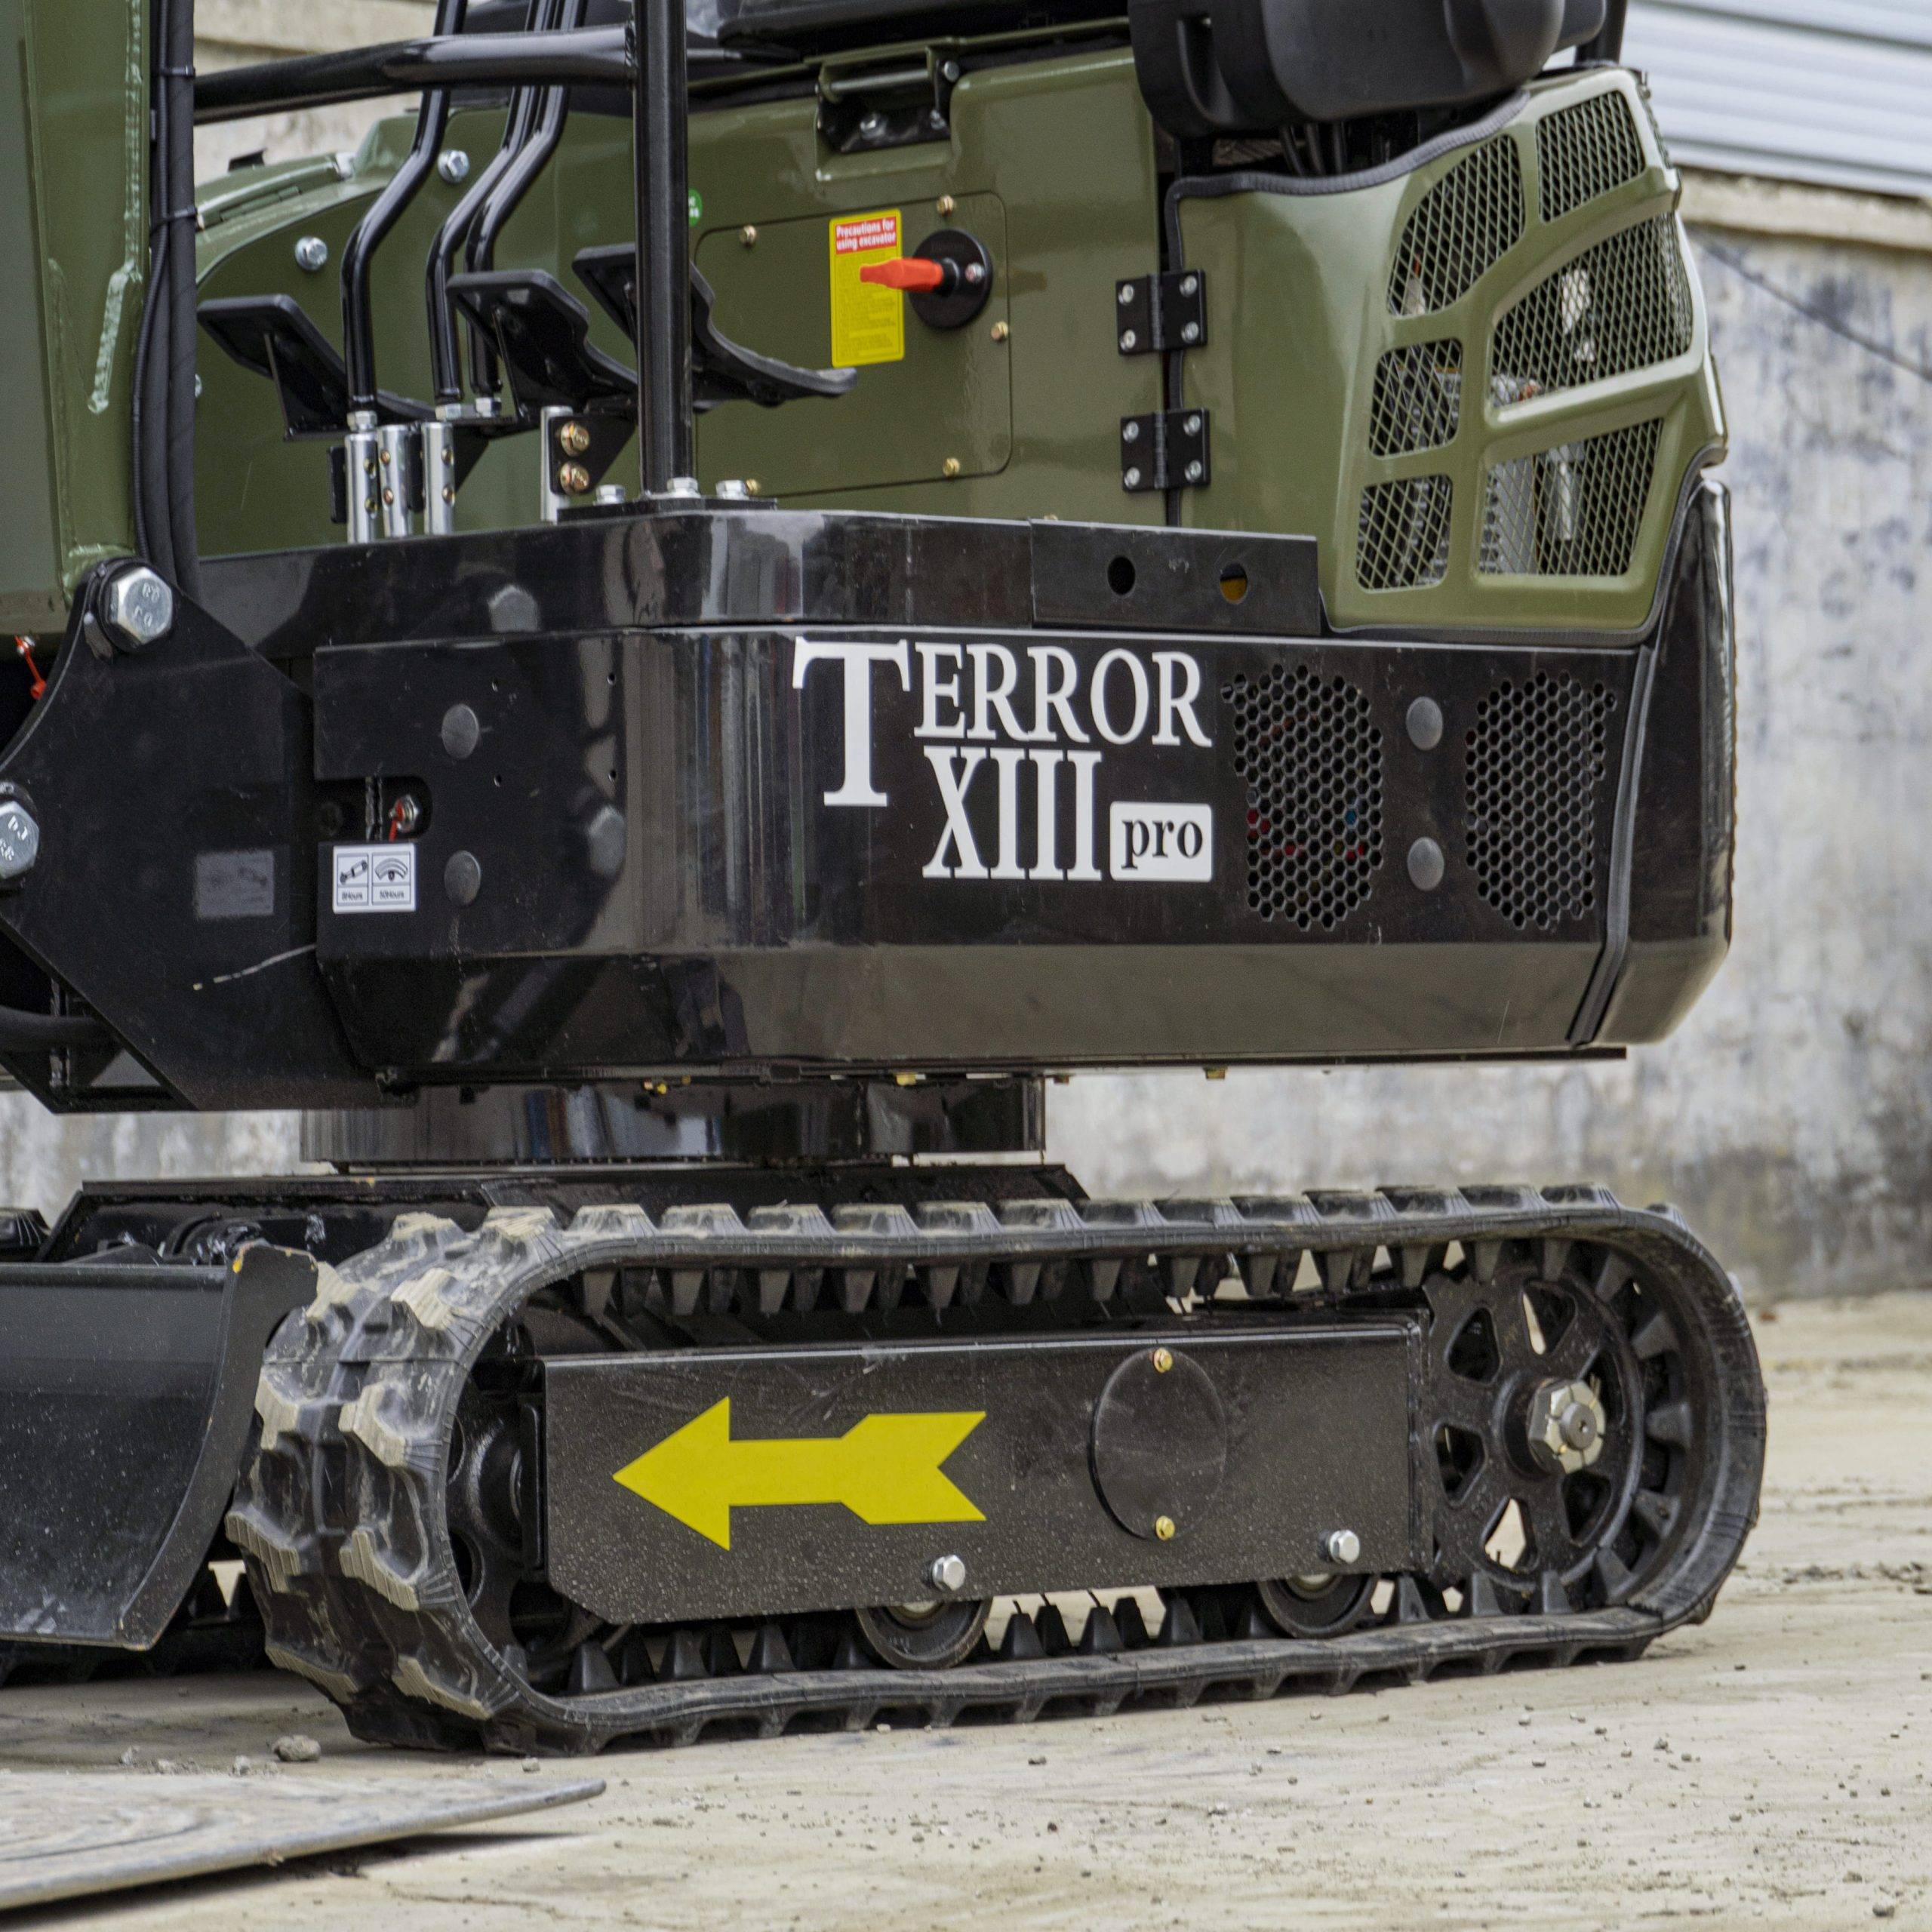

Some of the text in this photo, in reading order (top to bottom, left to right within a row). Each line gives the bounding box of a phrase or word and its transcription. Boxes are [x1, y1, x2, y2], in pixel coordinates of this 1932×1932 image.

[836, 219, 895, 237] Precautions for
[837, 232, 897, 250] using excavator
[792, 637, 1213, 807] TERROR
[922, 746, 1204, 881] XIII pro
